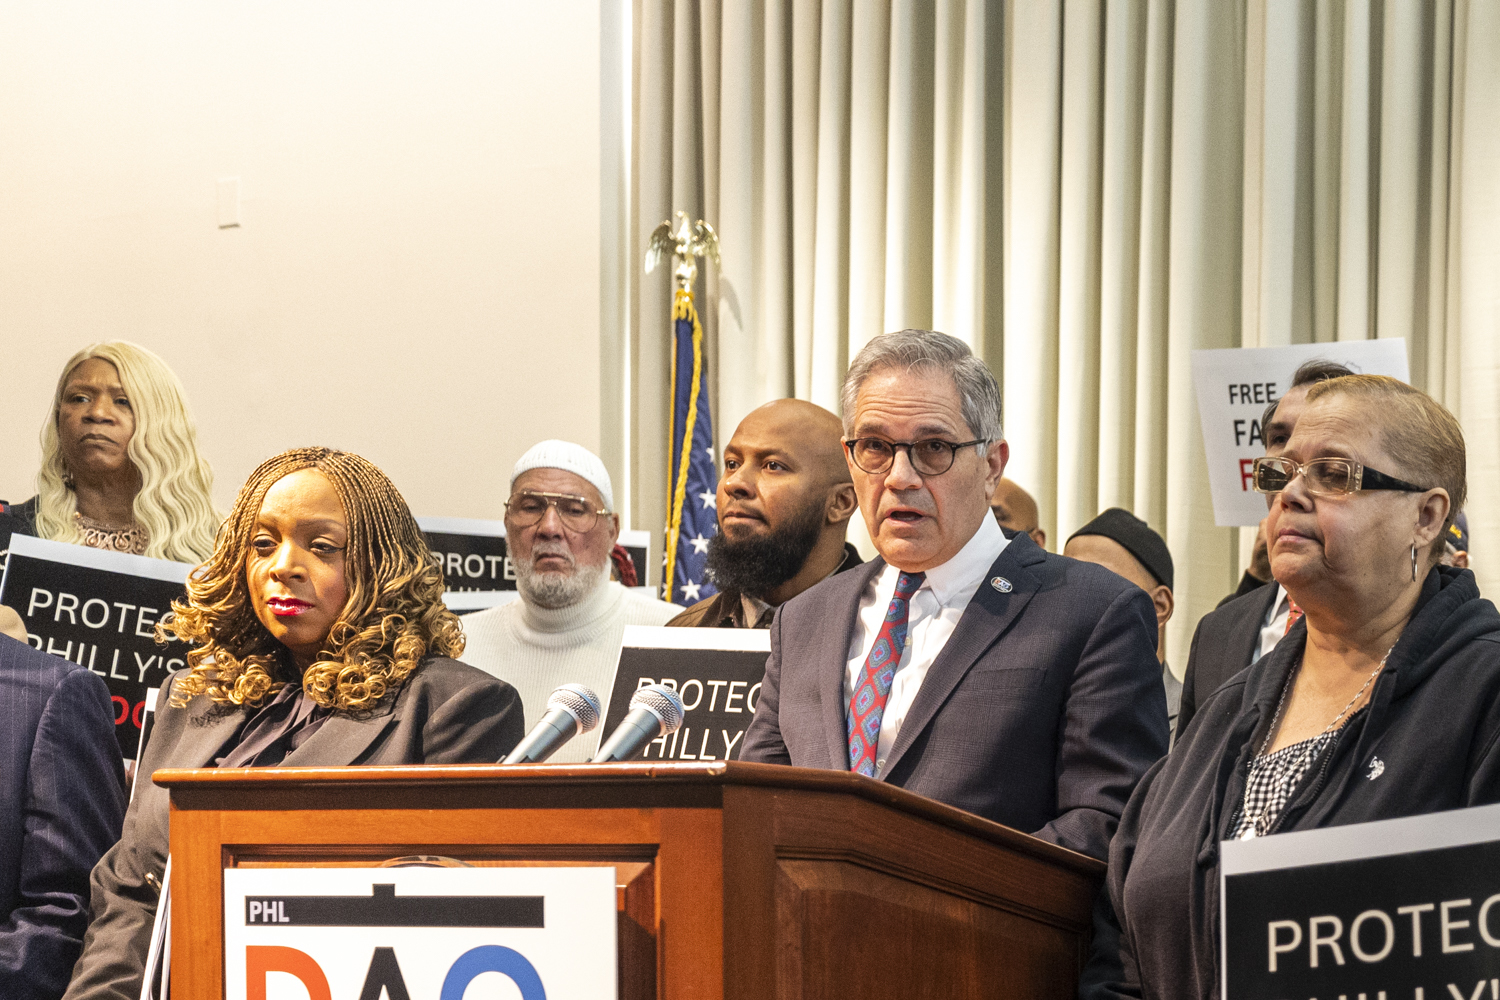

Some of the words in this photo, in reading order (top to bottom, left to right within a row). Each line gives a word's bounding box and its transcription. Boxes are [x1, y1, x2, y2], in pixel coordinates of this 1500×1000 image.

[1228, 382, 1277, 404] FREE
[1233, 418, 1265, 446] FA
[27, 587, 194, 645] PROTEC
[249, 901, 290, 923] PHL
